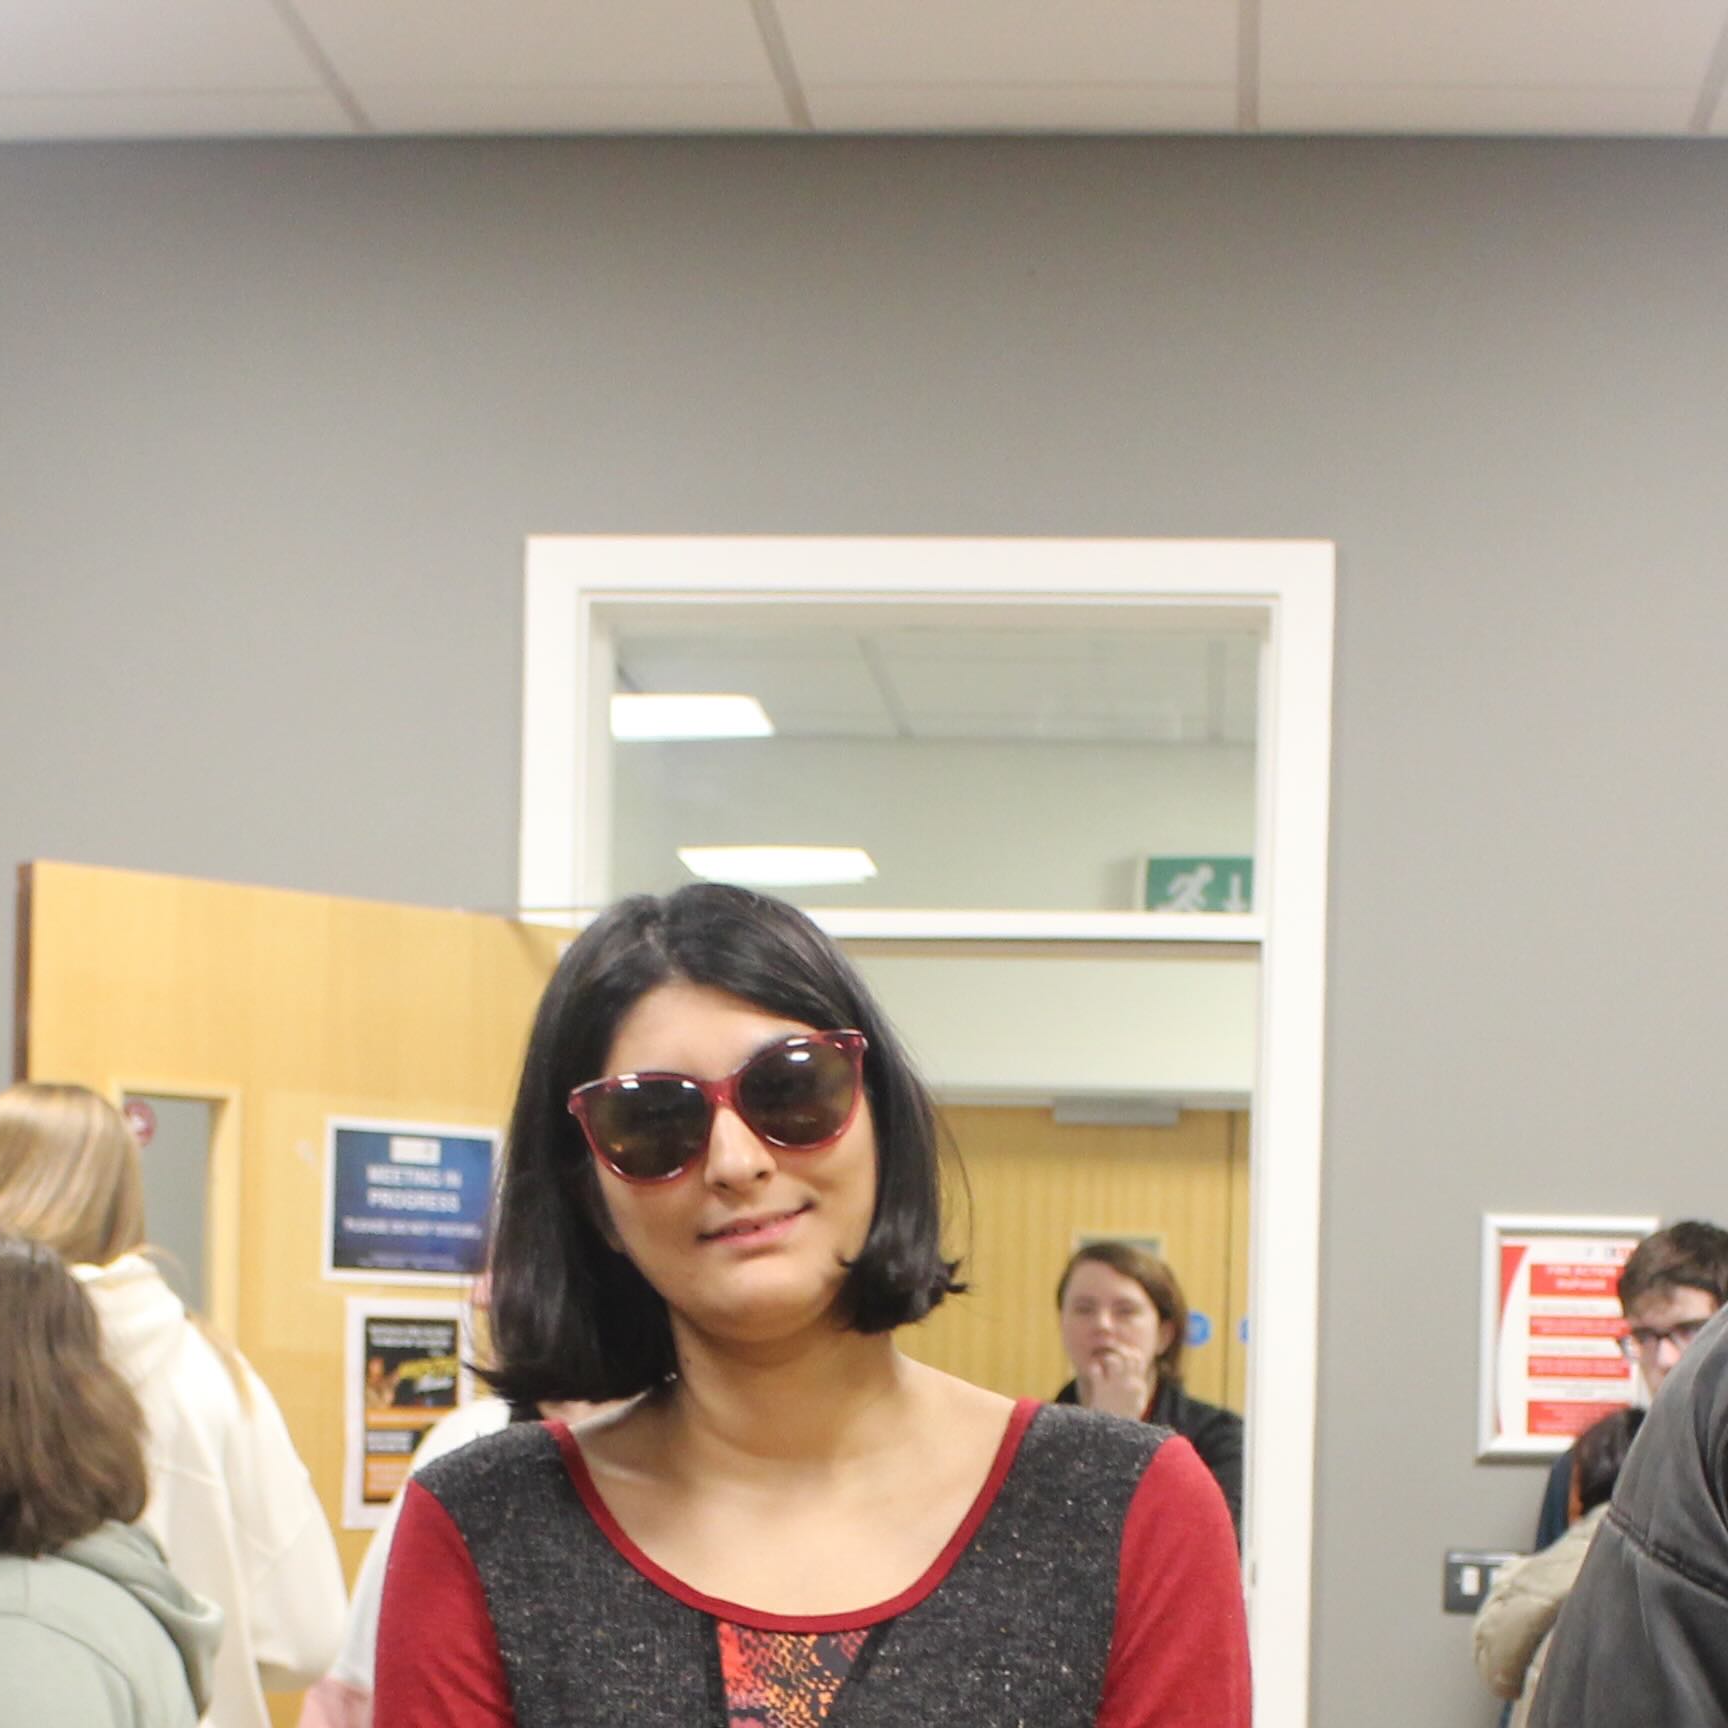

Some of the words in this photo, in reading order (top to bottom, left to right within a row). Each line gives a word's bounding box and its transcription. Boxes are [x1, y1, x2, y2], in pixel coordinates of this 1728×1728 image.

[367, 1164, 441, 1188] MEETING
[444, 1168, 463, 1189] IN
[367, 1187, 461, 1213] PROGRESS
